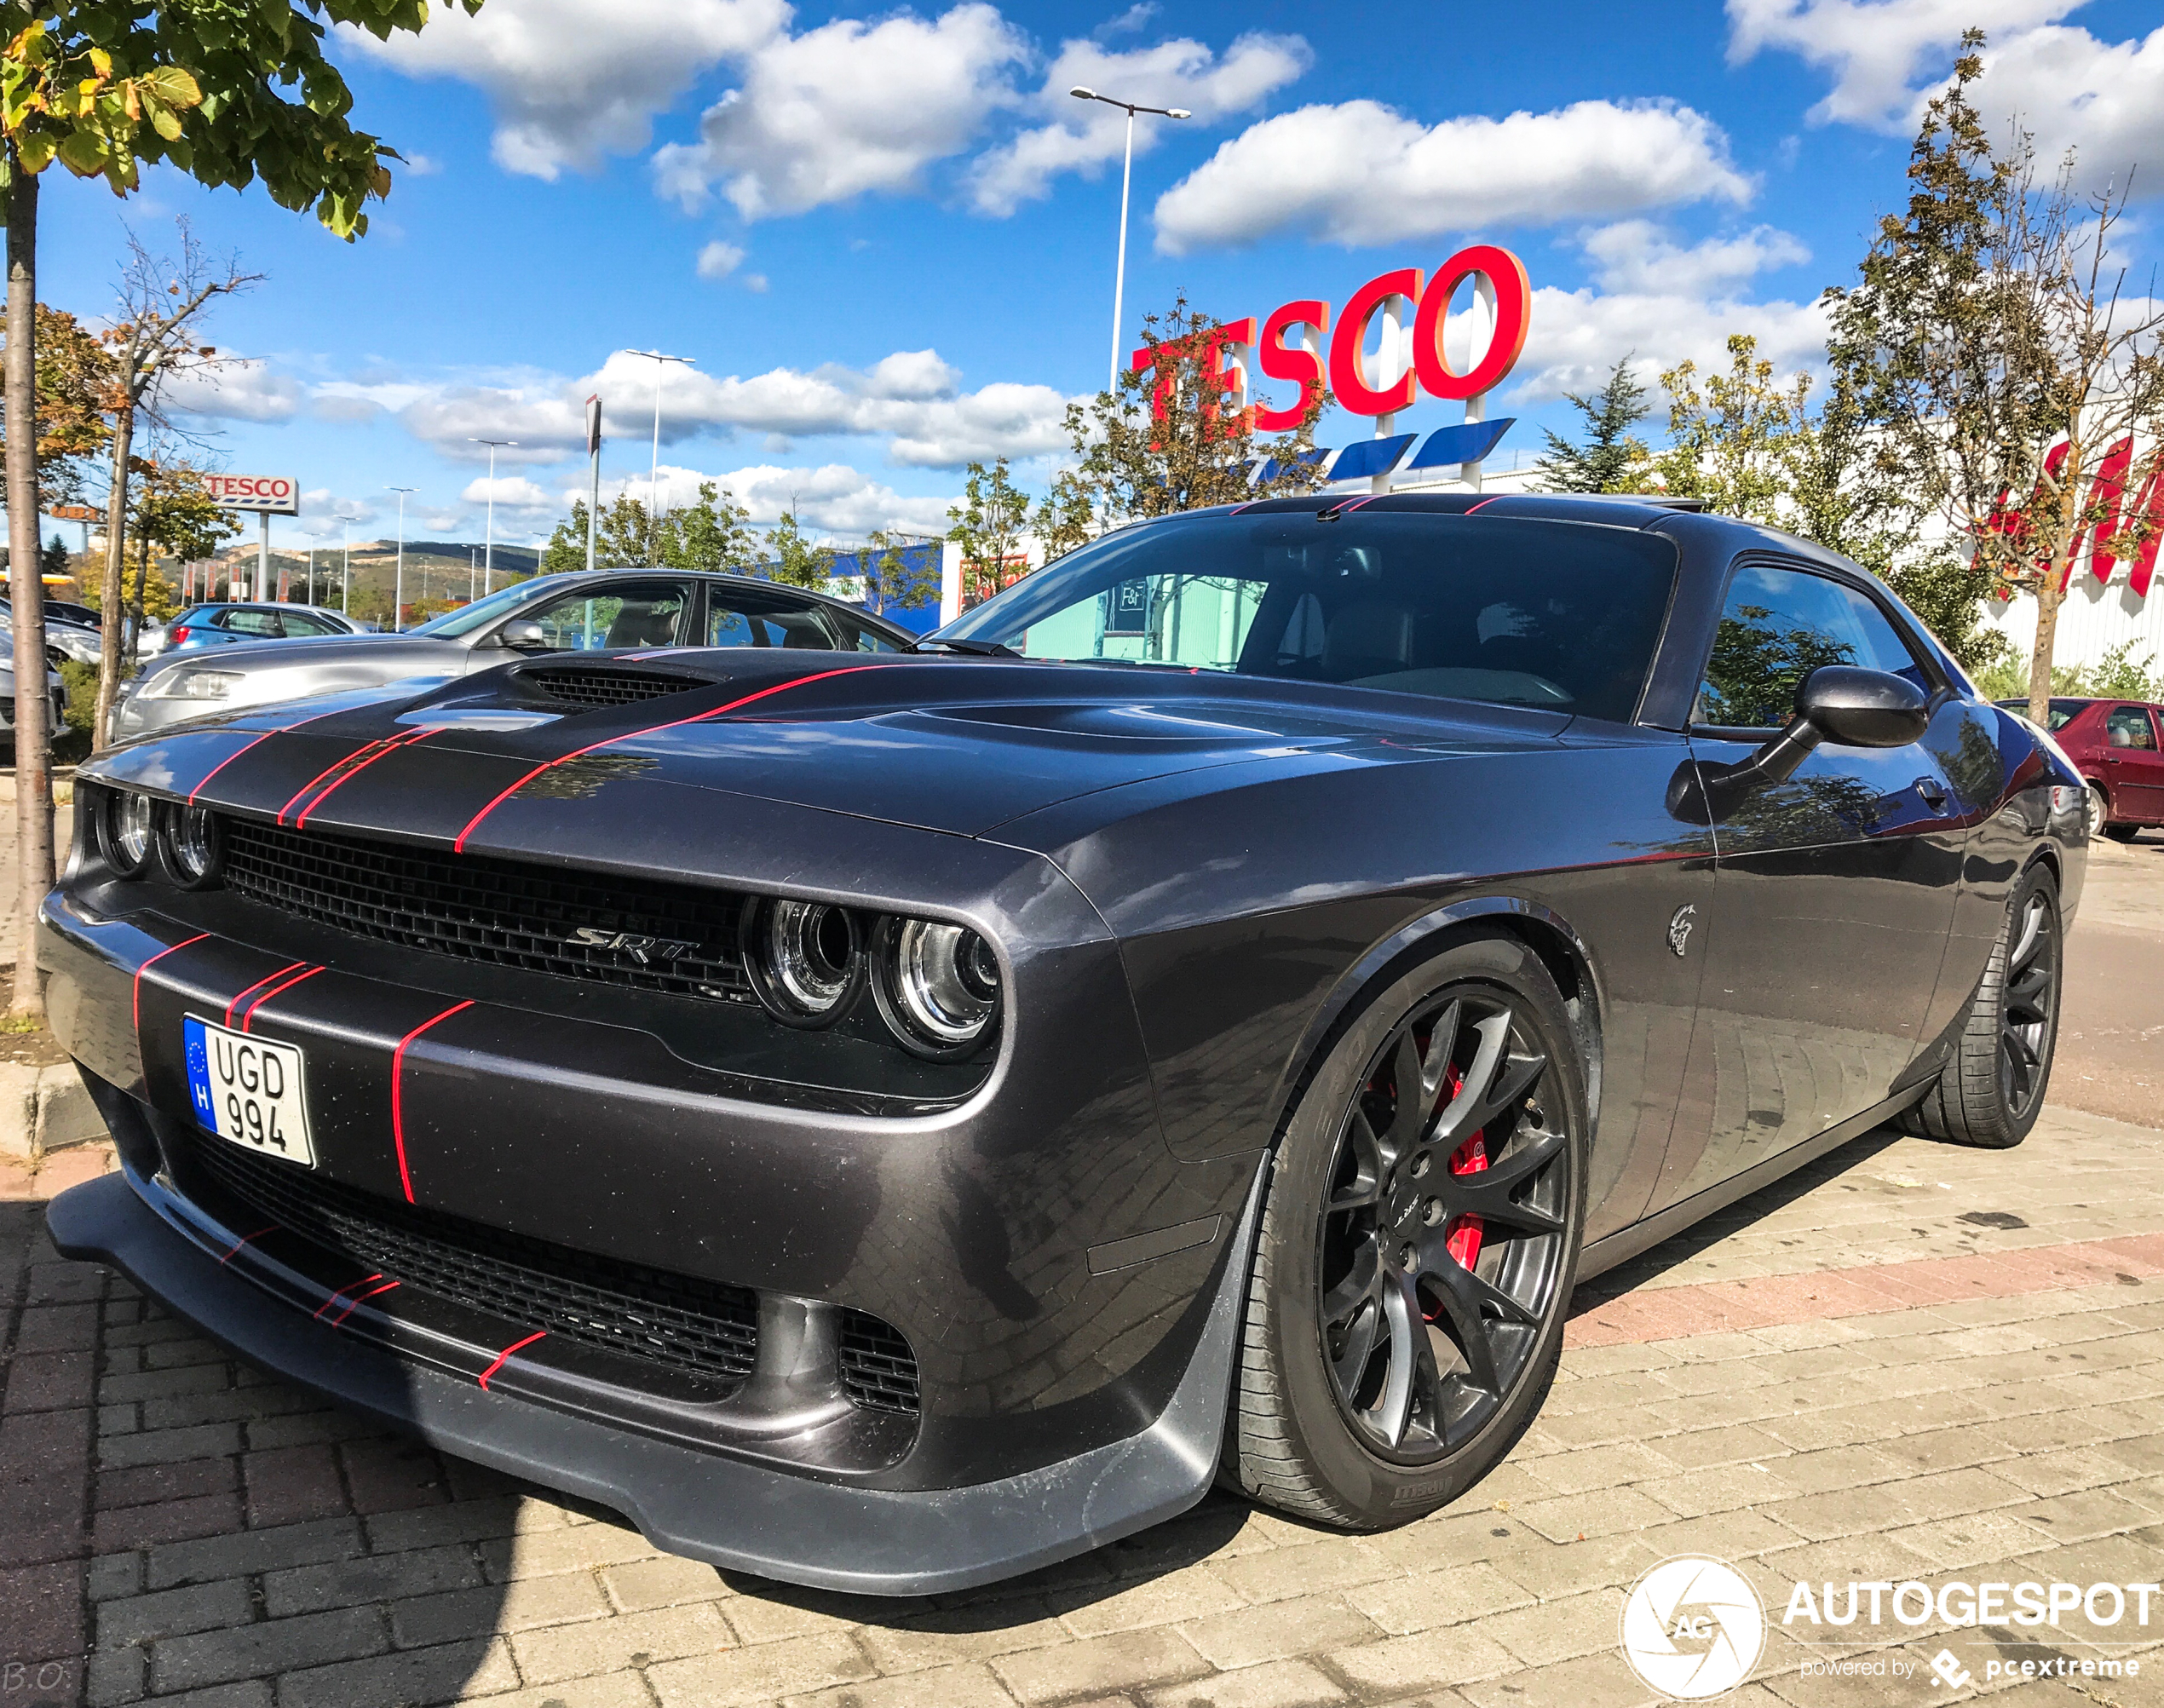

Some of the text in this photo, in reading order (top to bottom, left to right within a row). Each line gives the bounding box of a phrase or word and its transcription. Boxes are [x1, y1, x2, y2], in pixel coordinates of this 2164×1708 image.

[1131, 244, 1532, 452] TESCO
[204, 476, 290, 497] TESCO
[565, 927, 701, 963] SRT
[216, 1036, 285, 1100] UGD
[195, 1083, 210, 1111] H
[227, 1092, 286, 1152] 994
[1390, 1476, 1453, 1509] PIRELLI
